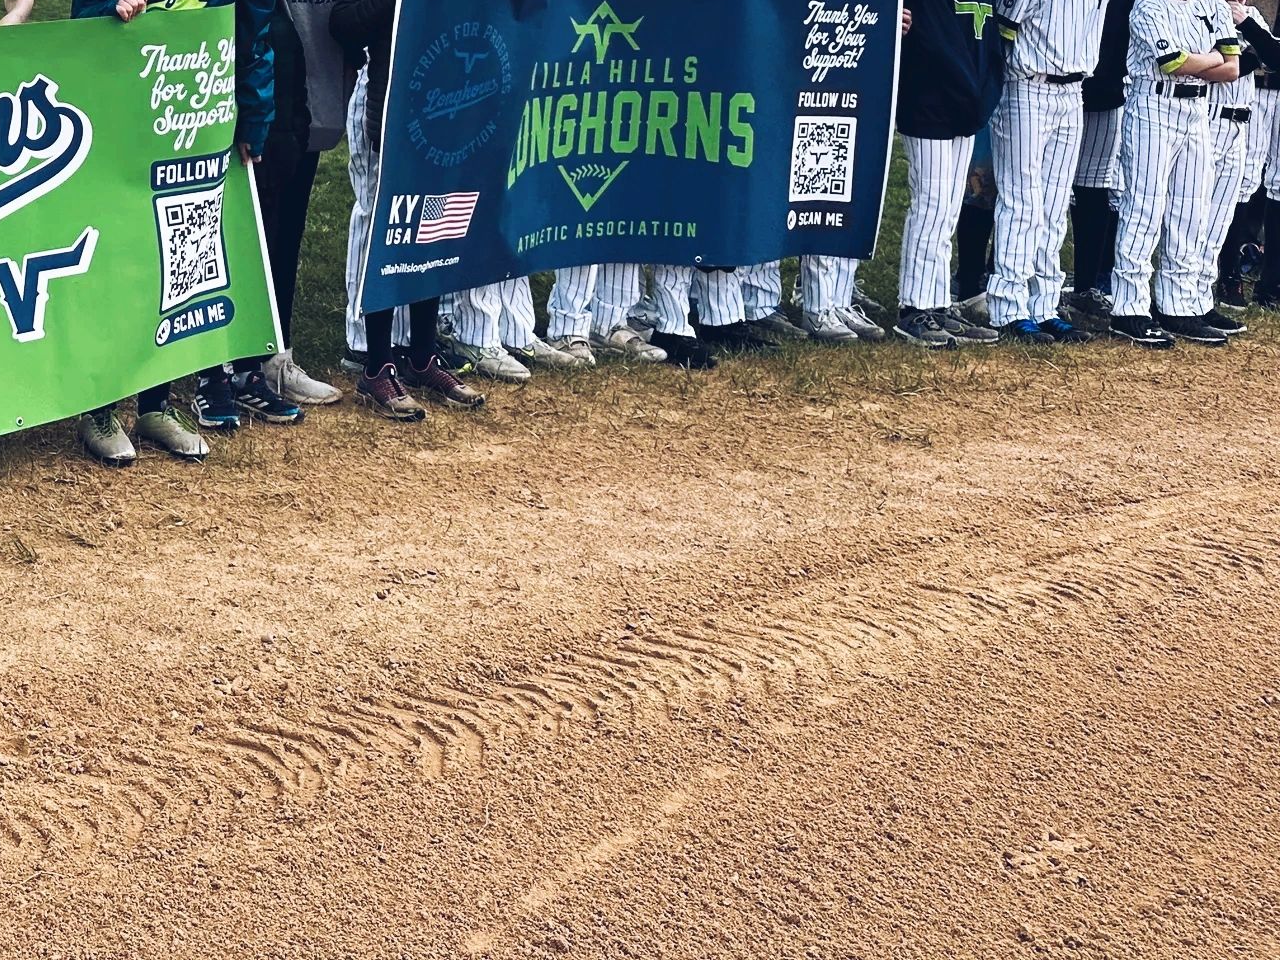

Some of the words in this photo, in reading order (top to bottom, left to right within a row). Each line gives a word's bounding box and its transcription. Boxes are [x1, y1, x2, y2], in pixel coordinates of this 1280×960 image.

[803, 0, 849, 25] Thank
[847, 3, 878, 32] You
[805, 23, 830, 50] for
[828, 25, 867, 53] Your
[139, 41, 212, 78] Thank
[409, 32, 450, 91] STRIVE
[454, 21, 481, 40] FOR
[609, 55, 699, 84] HILLS
[802, 46, 865, 83] Support!
[150, 73, 188, 110] for
[189, 71, 236, 109] You
[798, 91, 840, 108] FOLLOW
[841, 92, 858, 109] US
[406, 118, 428, 151] NOT
[424, 119, 498, 168] PERFECTION
[155, 159, 220, 186] FOLLOW
[388, 194, 420, 225] KY
[798, 211, 822, 227] SCAN
[825, 211, 844, 227] ME
[385, 227, 412, 246] USA
[517, 224, 569, 254] ATHLETIC
[575, 220, 697, 239] ASSOCIATION
[173, 310, 206, 334] SCAN
[207, 302, 227, 324] ME
